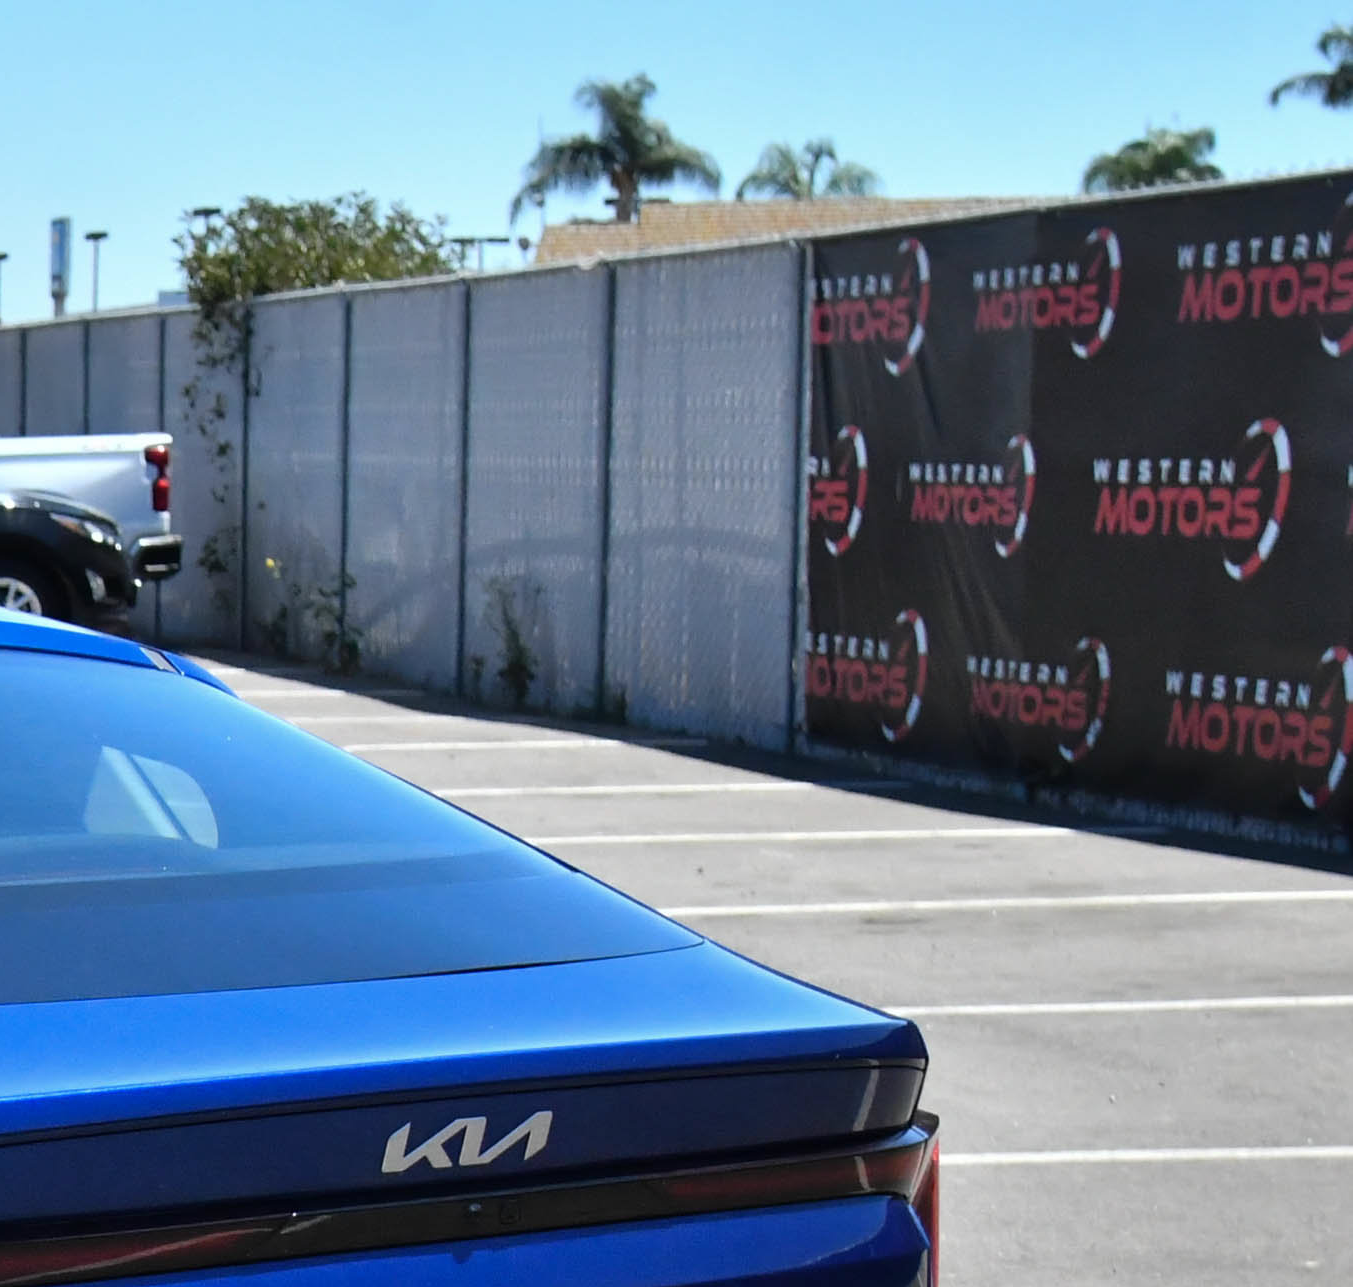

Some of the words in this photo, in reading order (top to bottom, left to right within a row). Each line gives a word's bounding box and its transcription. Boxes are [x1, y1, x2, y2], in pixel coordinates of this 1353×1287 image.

[1177, 229, 1333, 269] WESTERN
[973, 261, 1079, 291] WESTERN
[1178, 260, 1353, 322] MOTORS
[975, 284, 1100, 332] MOTORS
[908, 461, 1004, 485] WESTERN
[1093, 457, 1237, 485] WESTERN
[911, 485, 1017, 524] MOTORS
[1094, 487, 1261, 540] MOTORS
[966, 655, 1069, 685] WESTERN
[1166, 670, 1311, 708] WESTERN
[972, 683, 1087, 731] MOTORS
[1167, 700, 1331, 767] MOTORS
[381, 1110, 552, 1173] KIA
